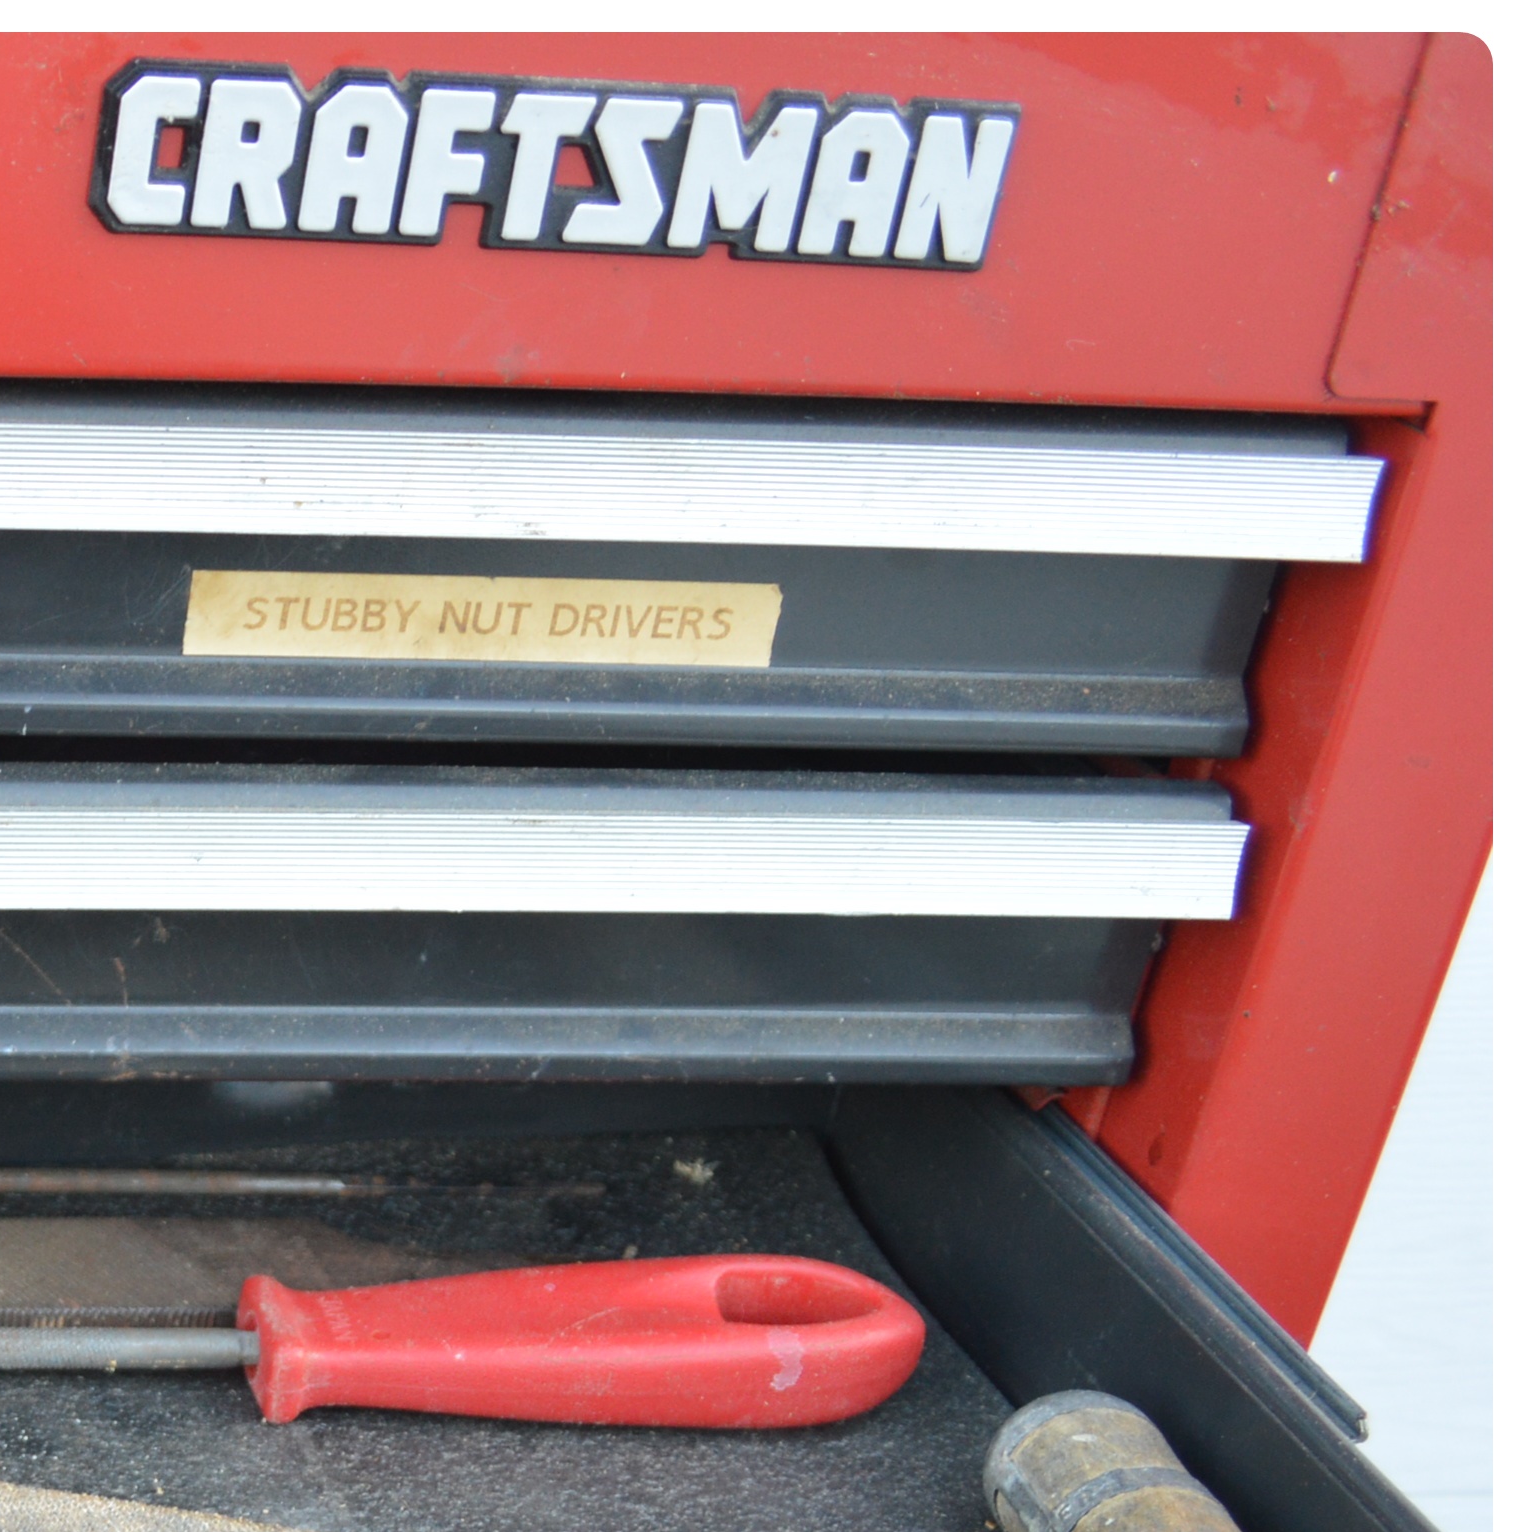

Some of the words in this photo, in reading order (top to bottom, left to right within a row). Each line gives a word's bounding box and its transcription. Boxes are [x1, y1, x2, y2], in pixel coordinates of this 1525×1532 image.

[106, 74, 1015, 263] CRAFTSMAN
[242, 596, 422, 635] STUBBY
[438, 599, 532, 636] NUT
[549, 604, 734, 641] DRIVERS
